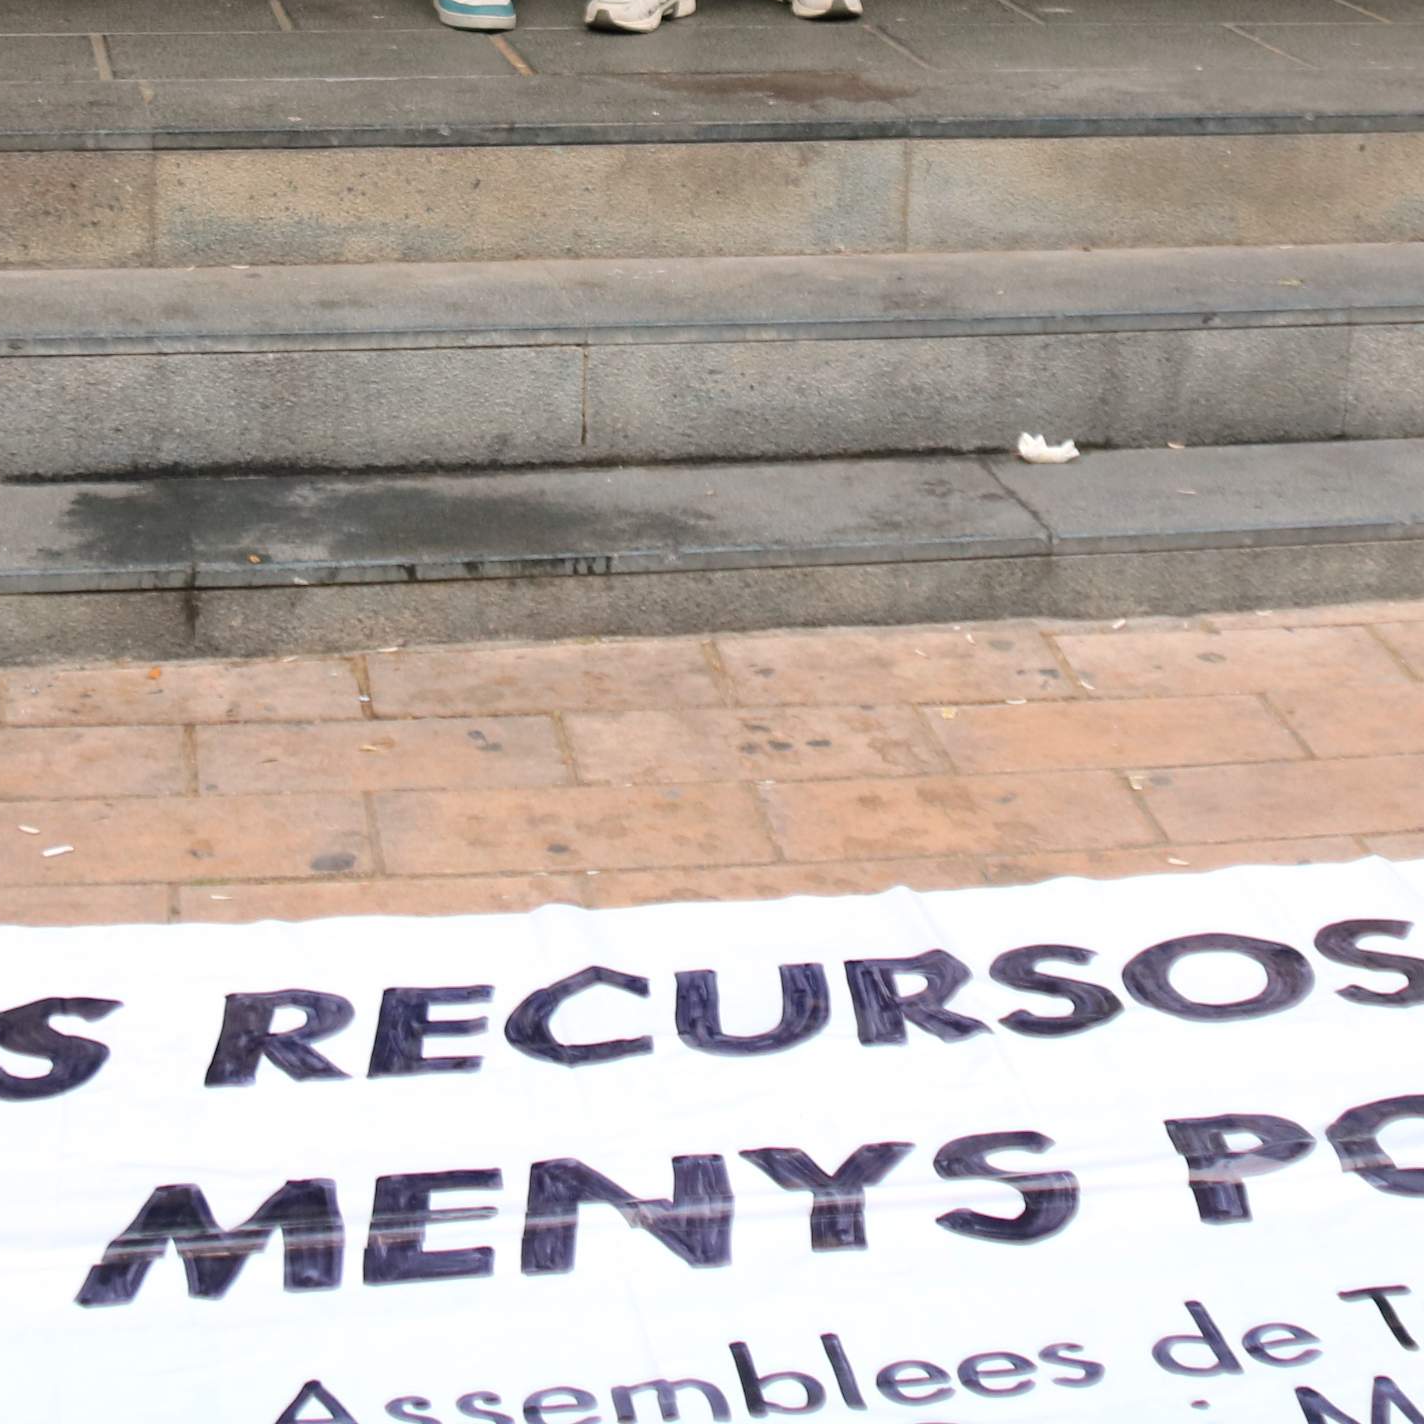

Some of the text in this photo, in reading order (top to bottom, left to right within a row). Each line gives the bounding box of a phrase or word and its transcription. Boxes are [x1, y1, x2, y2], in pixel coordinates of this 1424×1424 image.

[73, 1129, 1080, 1309] MENYS
[274, 1332, 1105, 1424] Assemblees
[1152, 1299, 1320, 1377] de
